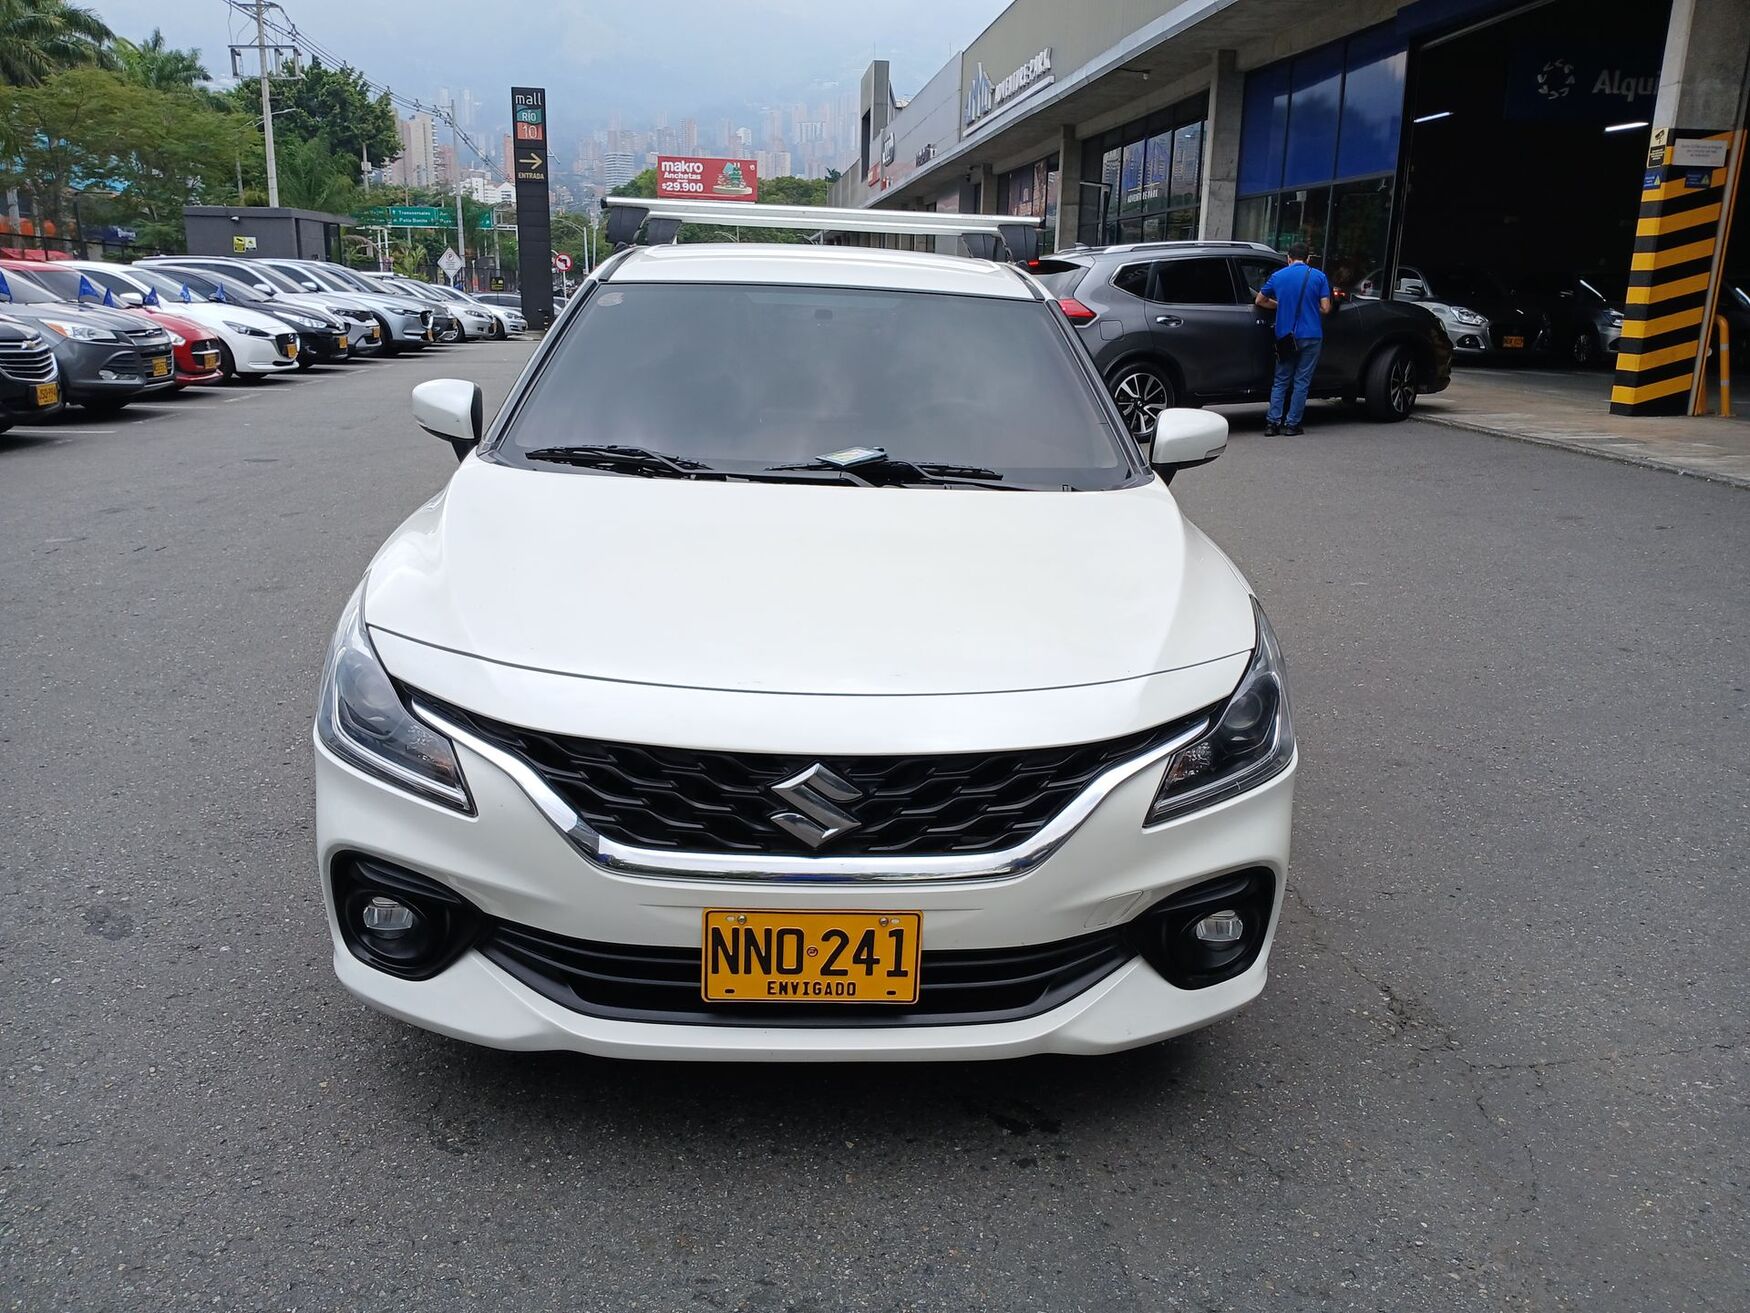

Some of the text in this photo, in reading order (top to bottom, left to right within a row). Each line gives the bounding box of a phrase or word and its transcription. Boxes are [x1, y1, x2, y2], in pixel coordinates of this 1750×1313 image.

[515, 92, 542, 106] mall
[522, 125, 538, 140] 10
[661, 160, 704, 173] makro
[518, 171, 546, 181] ENTRADA
[663, 171, 702, 181] Anchetas
[661, 182, 704, 193] $29.900
[710, 926, 909, 978] NNO 241
[766, 979, 858, 997] ENVIGADO
